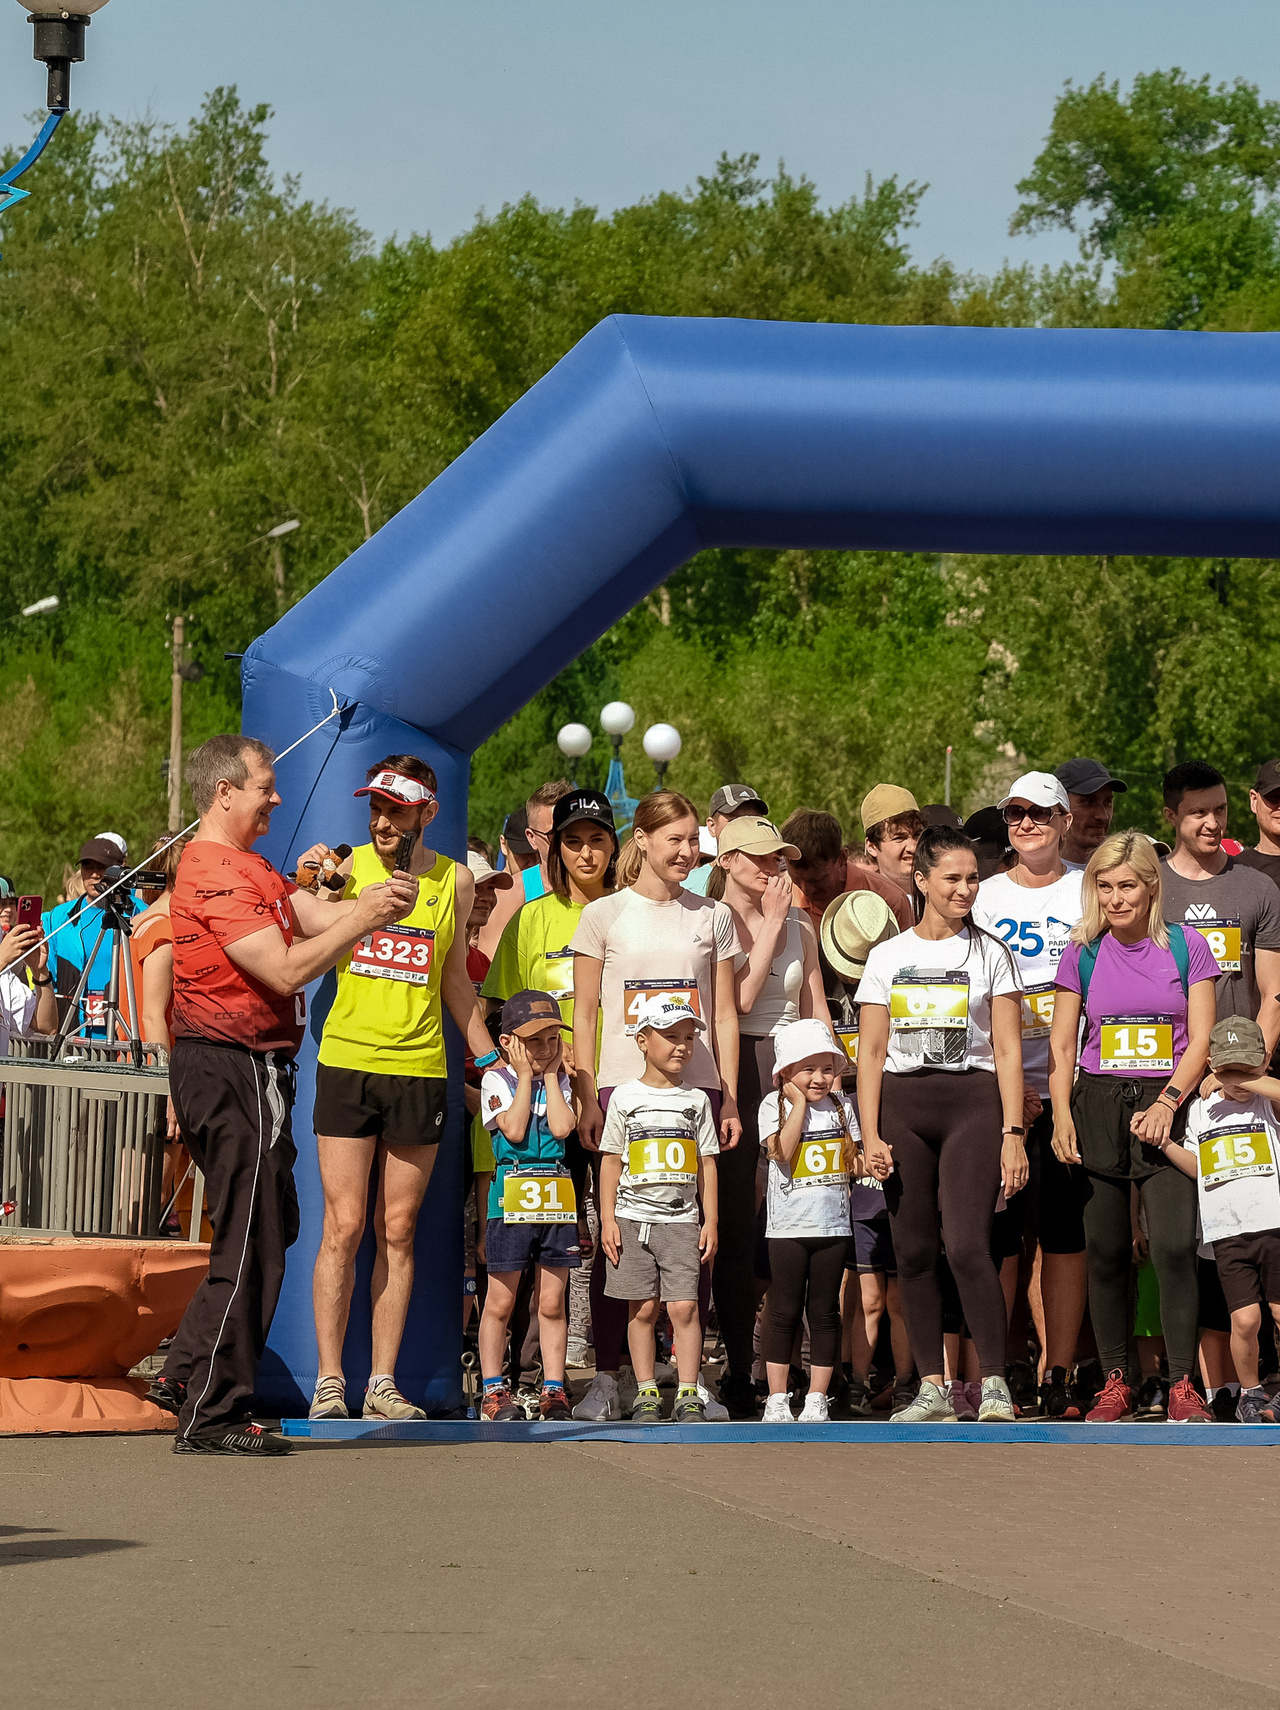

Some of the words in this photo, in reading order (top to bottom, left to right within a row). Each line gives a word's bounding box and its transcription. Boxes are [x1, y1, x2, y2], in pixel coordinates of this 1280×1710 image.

[570, 798, 600, 811] FILA
[357, 934, 429, 967] 1323
[995, 918, 1044, 957] 25
[1206, 931, 1227, 958] 8
[1114, 1028, 1158, 1057] 15
[1227, 1031, 1239, 1044] LA
[644, 1141, 685, 1170] 10
[805, 1142, 841, 1173] 67
[1211, 1136, 1256, 1170] 15
[519, 1180, 563, 1210] 31
